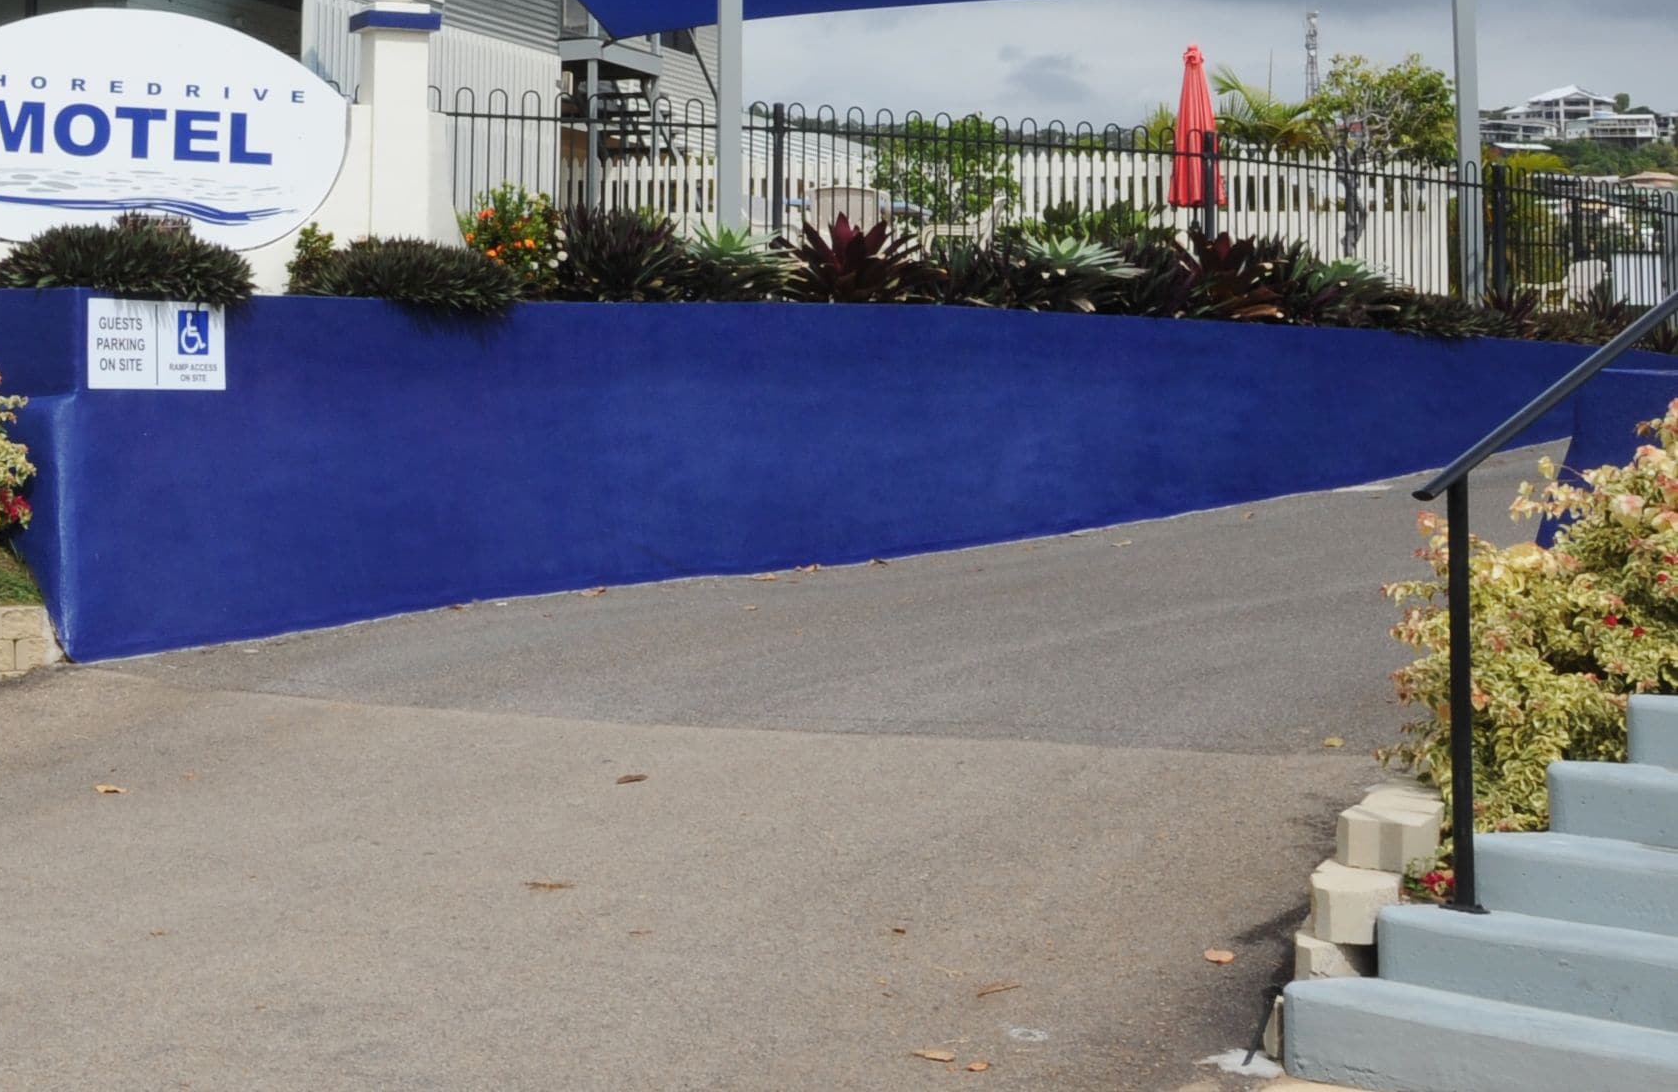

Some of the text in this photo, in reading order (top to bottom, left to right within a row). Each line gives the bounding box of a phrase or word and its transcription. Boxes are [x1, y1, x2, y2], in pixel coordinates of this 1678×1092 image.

[99, 316, 143, 331] GUESTS
[97, 338, 145, 351] PARKING
[99, 358, 143, 372] ON SITE
[169, 363, 218, 372] RAMP ACCESS
[180, 374, 207, 382] ON SITE
